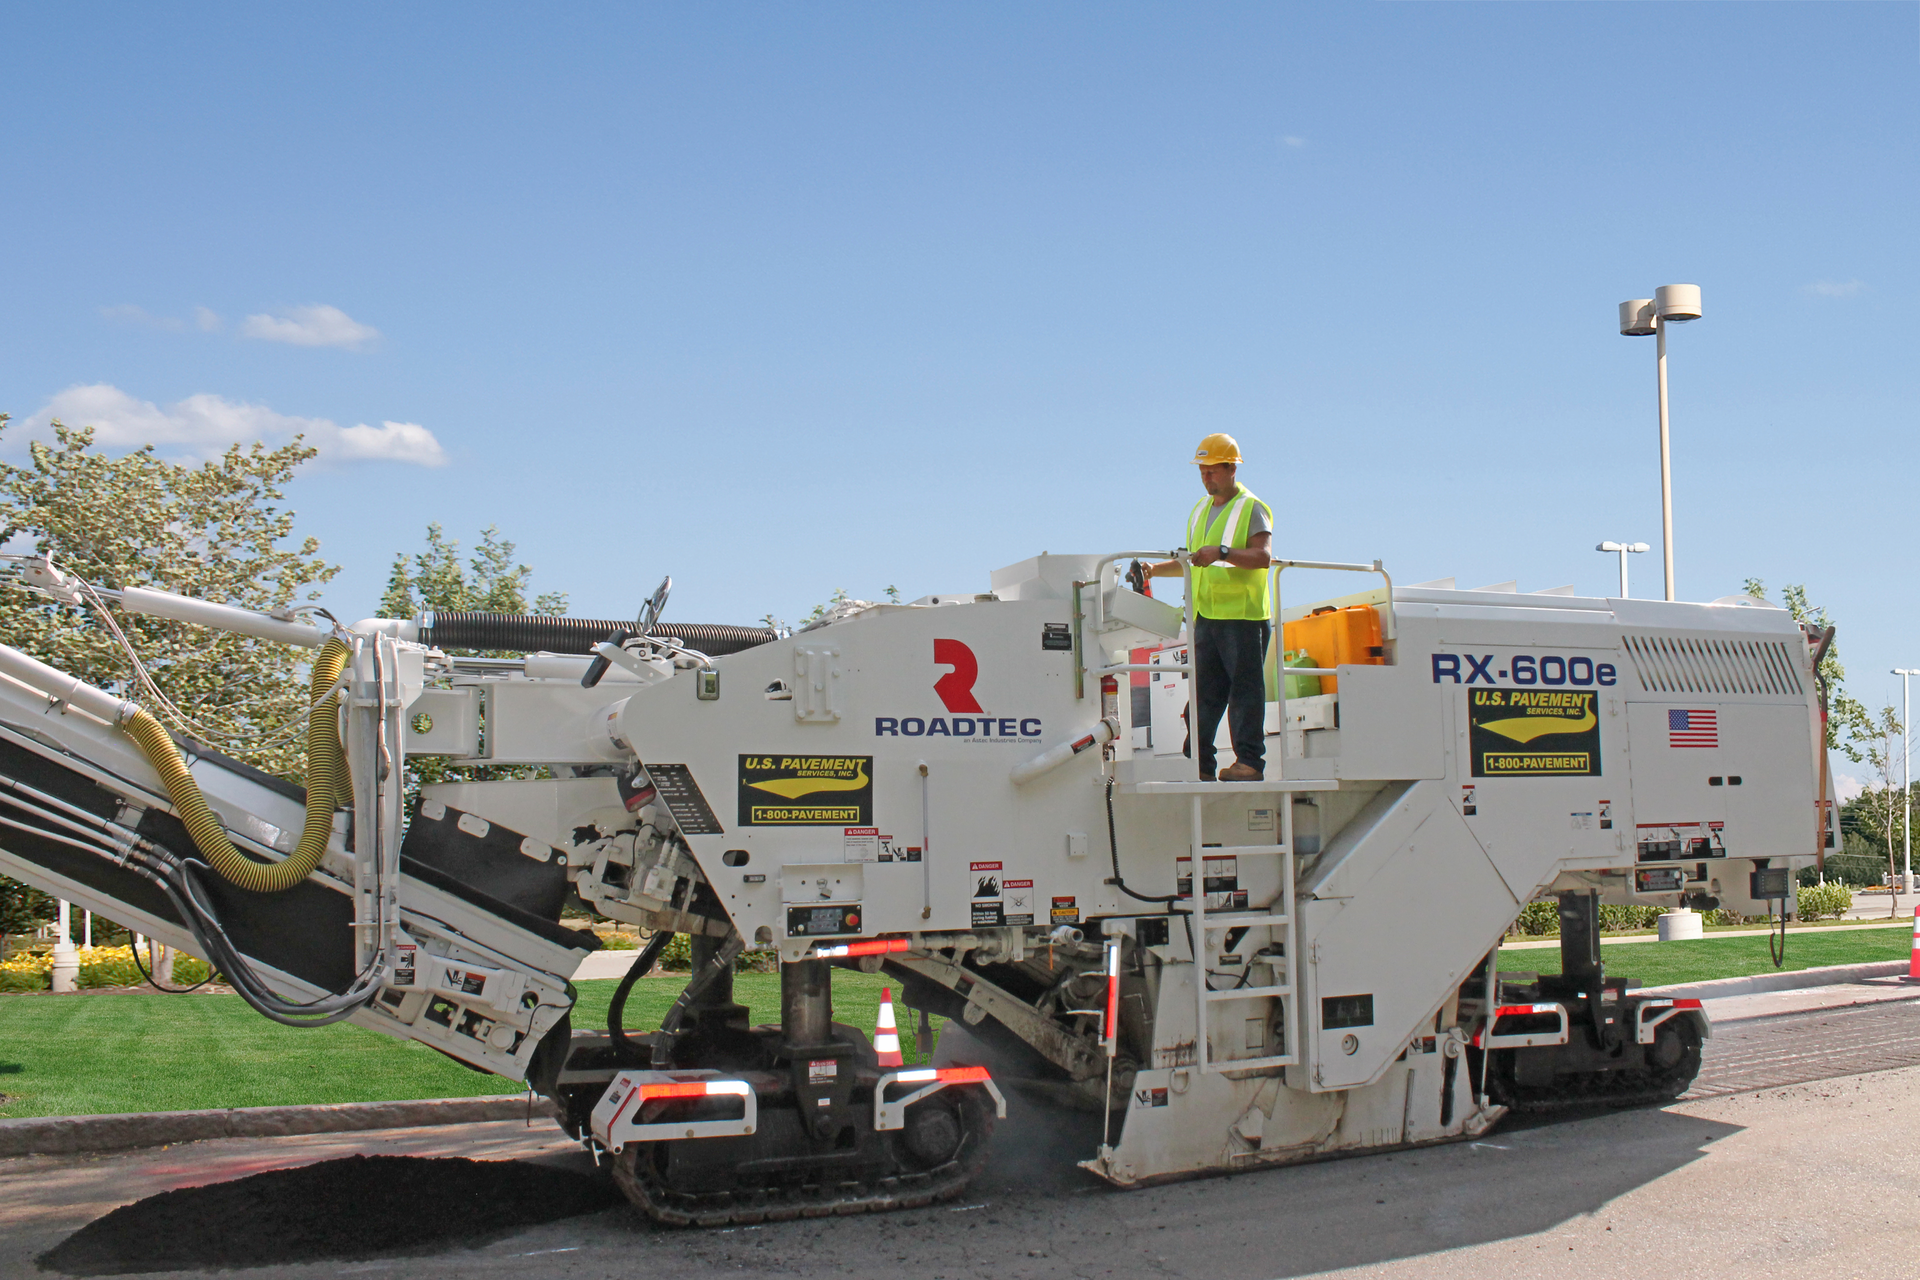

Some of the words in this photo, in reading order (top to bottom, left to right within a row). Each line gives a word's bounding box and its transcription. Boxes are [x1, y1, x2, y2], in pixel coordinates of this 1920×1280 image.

[1431, 653, 1617, 686] RX-600e
[1474, 691, 1506, 706] U.S.
[1510, 692, 1593, 707] PAVEMENT
[1526, 707, 1565, 716] SERVICES,
[875, 717, 1042, 737] ROADTEC
[745, 757, 776, 769] U.S.
[780, 758, 867, 770] PAVEMENT
[1487, 757, 1586, 769] 1-800-PAVEMENT
[756, 809, 856, 819] 1-800-PAVEMENT
